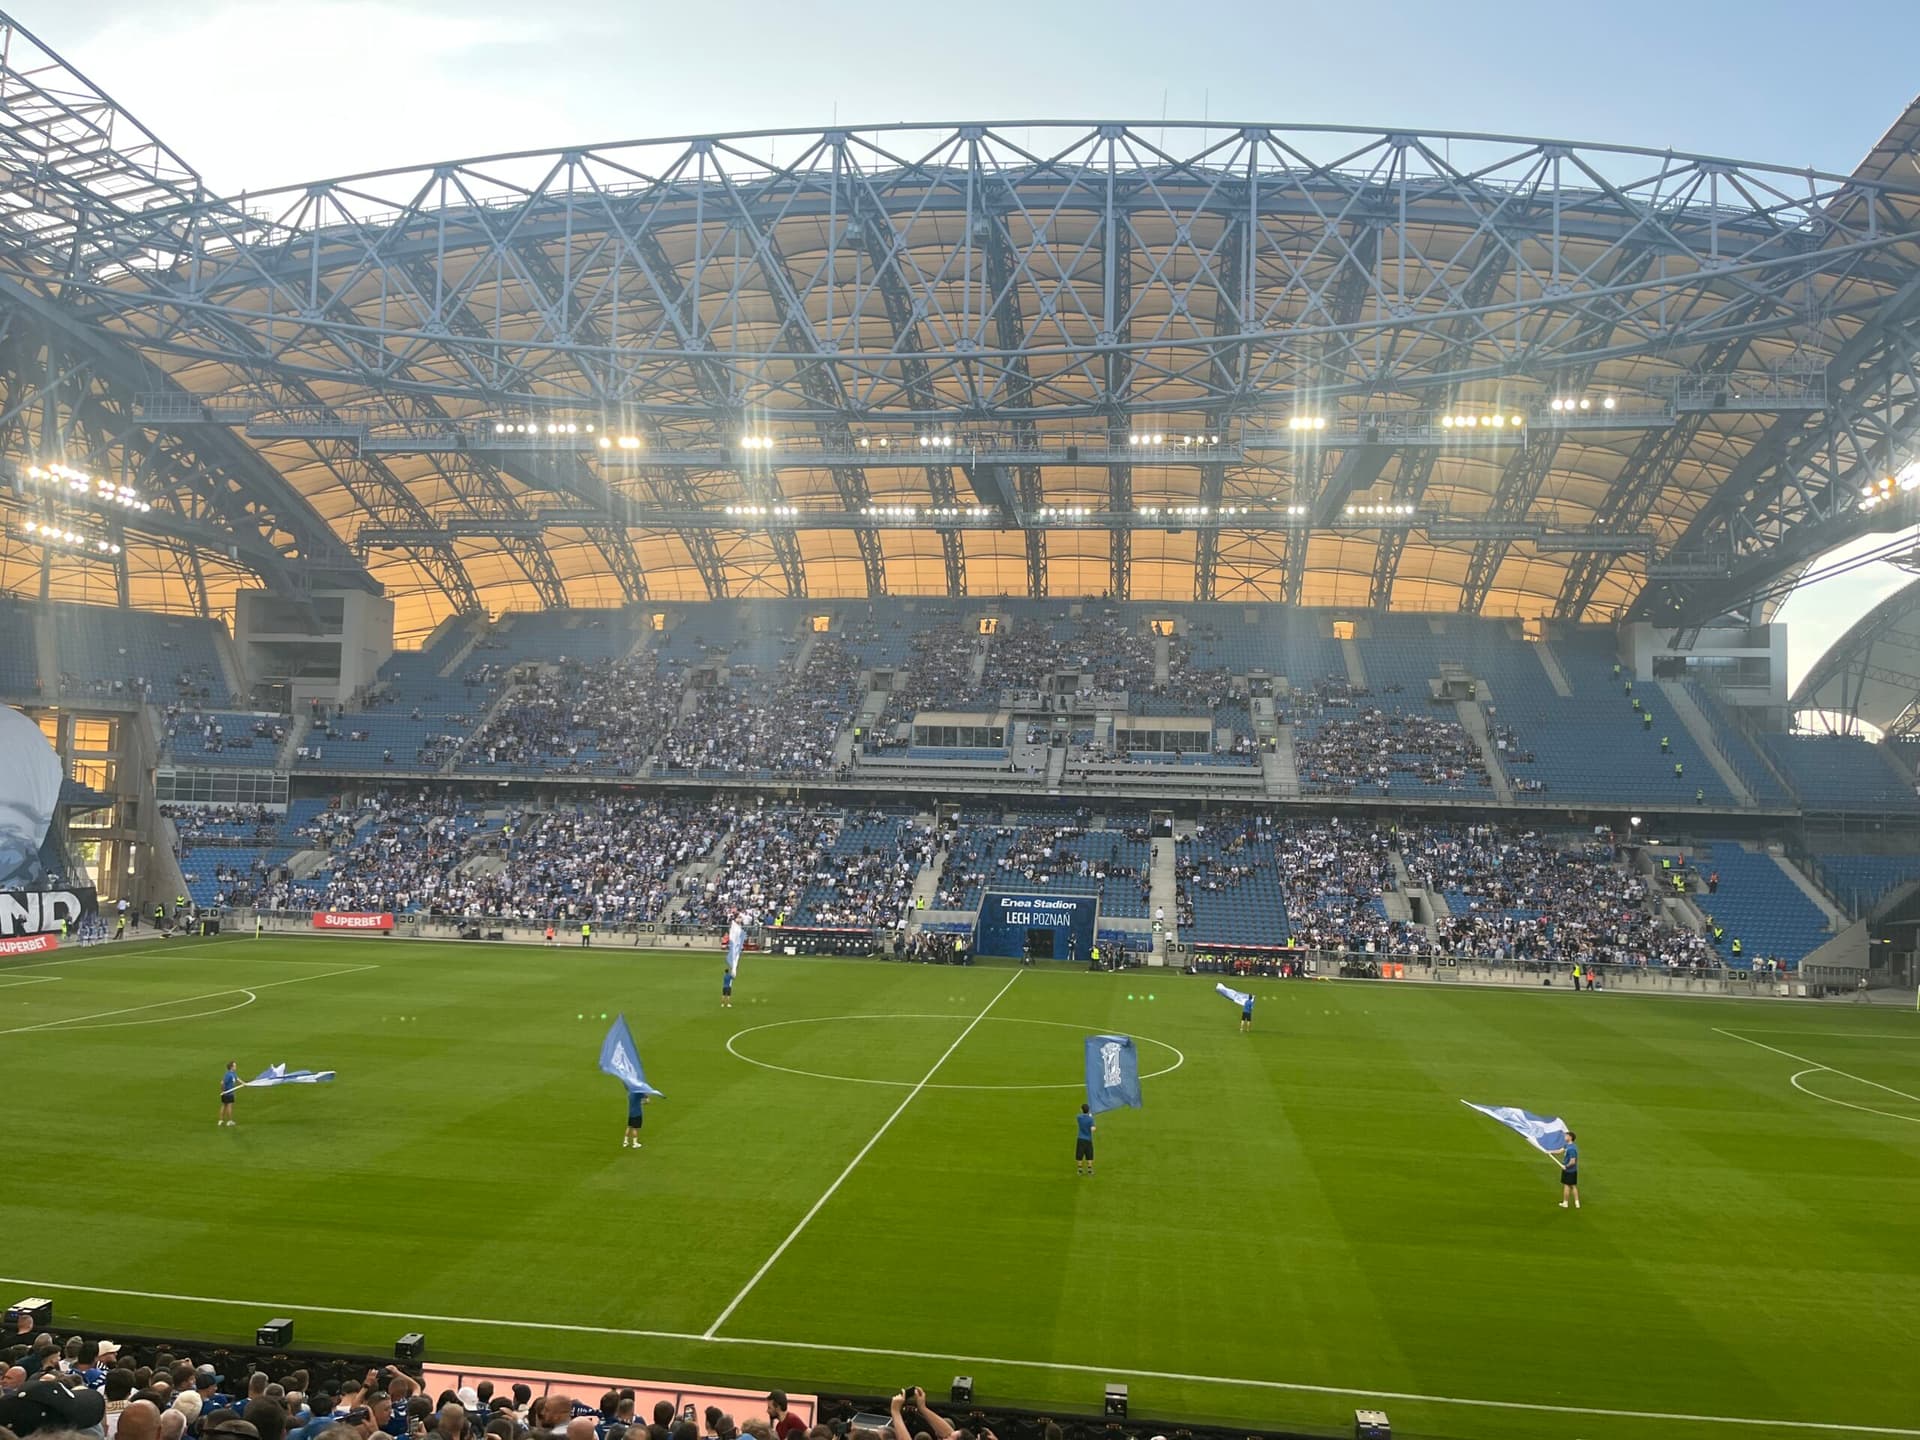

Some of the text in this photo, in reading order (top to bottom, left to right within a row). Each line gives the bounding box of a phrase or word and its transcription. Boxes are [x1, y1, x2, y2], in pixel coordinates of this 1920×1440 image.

[1001, 898, 1076, 909] Enea Stadion
[325, 914, 382, 927] SUPERBET
[1006, 911, 1071, 927] LECH POZNAŃ
